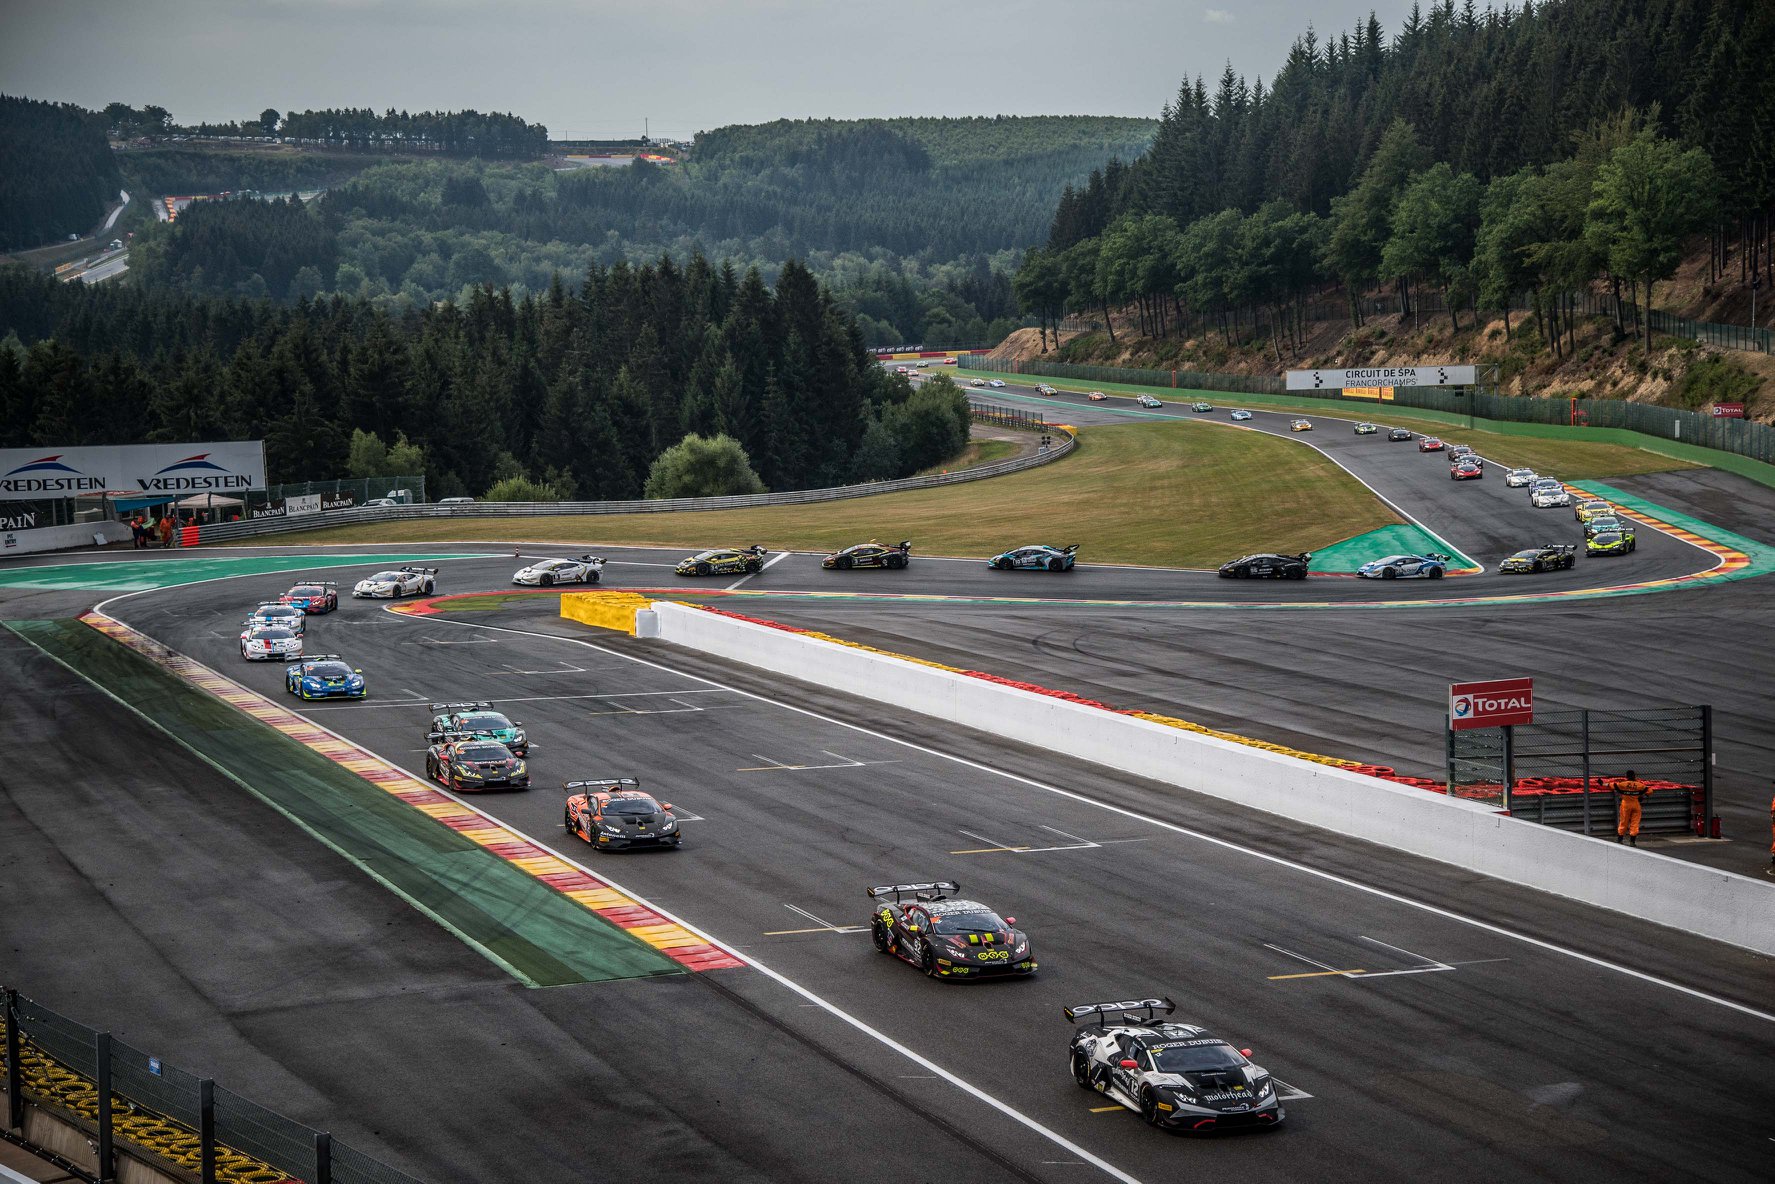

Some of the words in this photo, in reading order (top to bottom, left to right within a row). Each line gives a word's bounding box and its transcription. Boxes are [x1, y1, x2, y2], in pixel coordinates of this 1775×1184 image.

[1345, 369, 1381, 378] CIRCUIT
[1384, 369, 1396, 377] DE
[1398, 368, 1416, 377] SPA
[1345, 378, 1417, 388] FRANCORCHAMPS
[136, 474, 252, 491] VREDESTEIN
[1473, 697, 1532, 712] TOTAL
[1152, 1041, 1187, 1050] ROGER
[1187, 1038, 1224, 1046] DUBUIS
[1131, 1080, 1139, 1097] 12
